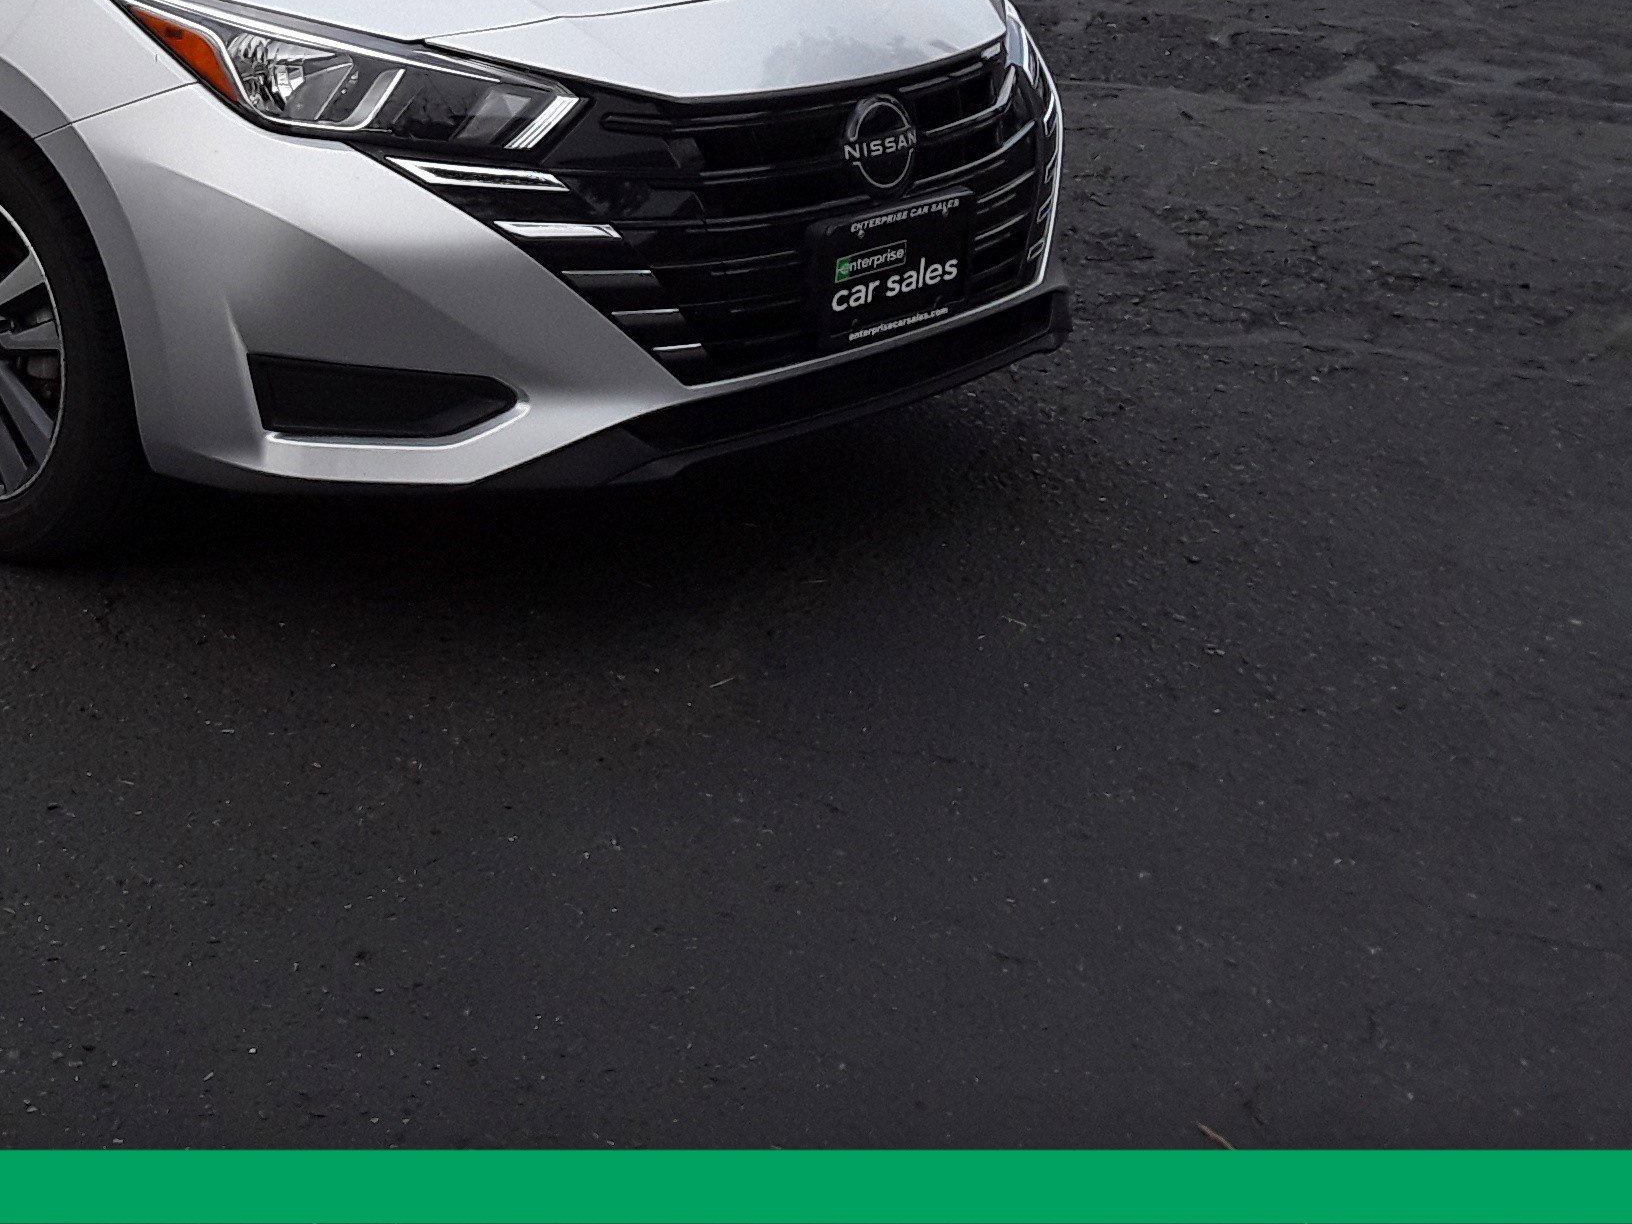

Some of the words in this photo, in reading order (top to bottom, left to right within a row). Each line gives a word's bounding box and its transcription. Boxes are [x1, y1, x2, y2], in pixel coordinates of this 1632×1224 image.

[844, 129, 917, 160] NISSAN
[851, 210, 909, 233] ENTERPRISE
[910, 205, 930, 218] CAR
[931, 198, 960, 213] SALES
[838, 248, 905, 274] enterprise
[831, 279, 880, 312] car
[886, 256, 958, 297] sales
[848, 307, 949, 341] enterprisecarsales.com
